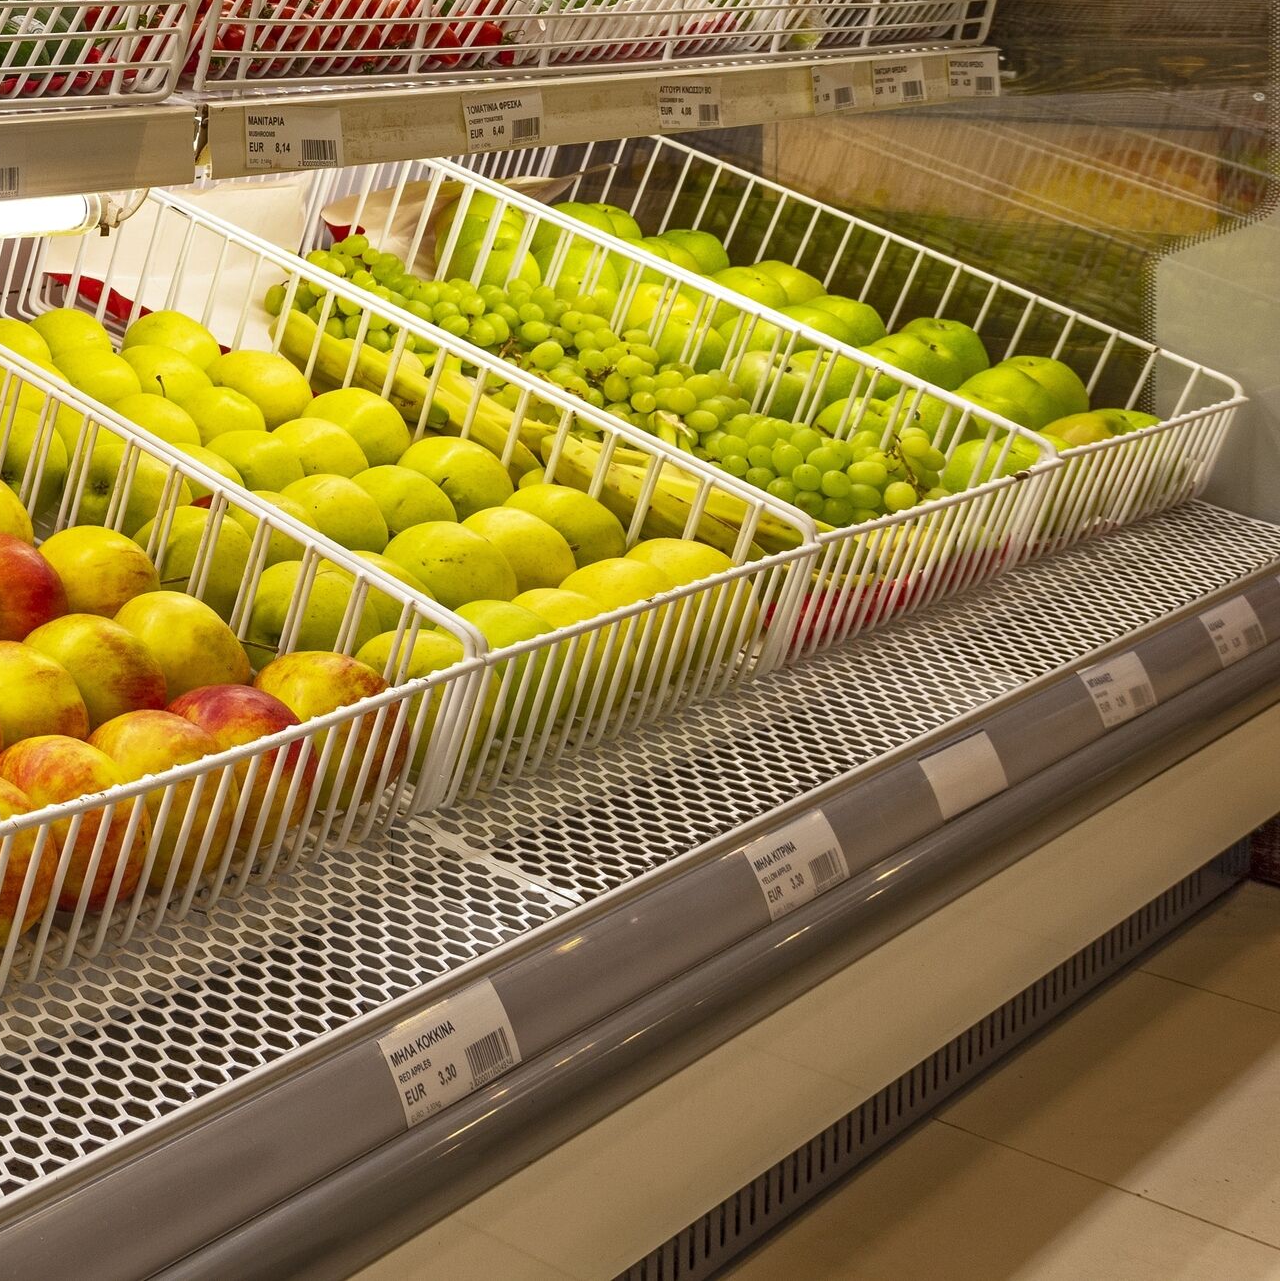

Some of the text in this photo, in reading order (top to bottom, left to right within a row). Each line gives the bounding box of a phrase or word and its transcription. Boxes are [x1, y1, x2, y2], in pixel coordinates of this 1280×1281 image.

[467, 100, 522, 115] ΤΟΜΑΤΙΝΙΑ ΦΡΕΣΚΑ
[660, 107, 673, 115] EUR
[248, 116, 285, 126] ΜΑΝΙΤΑΡΙΑ
[471, 126, 504, 139] EUR 6,40
[249, 142, 290, 154] EUR 8,14
[753, 841, 797, 872] ΜΗΛΑ ΚΙΤΡΙΝΑ
[768, 885, 784, 903] EUR
[390, 1020, 455, 1067] ΜΗΛΑ ΚΟΚΚΙΝΑ
[398, 1059, 432, 1084] RED APPLES
[405, 1063, 457, 1106] EUR 3,30
